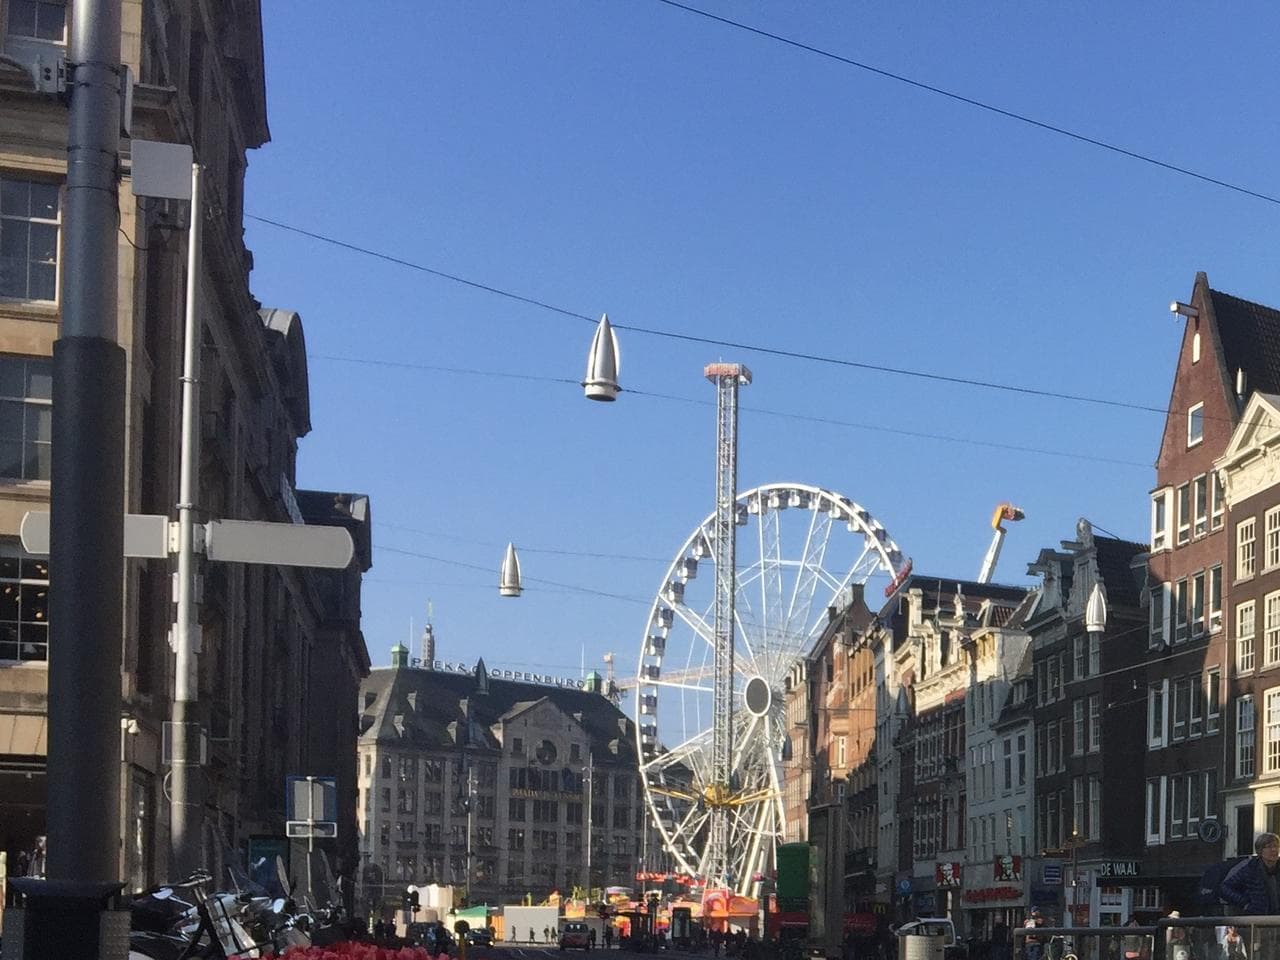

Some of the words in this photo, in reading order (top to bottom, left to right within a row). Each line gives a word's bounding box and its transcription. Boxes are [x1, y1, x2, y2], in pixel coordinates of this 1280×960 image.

[471, 665, 585, 688] COPPENBURG
[1101, 863, 1111, 876] DE
[1113, 862, 1138, 876] WAAL
